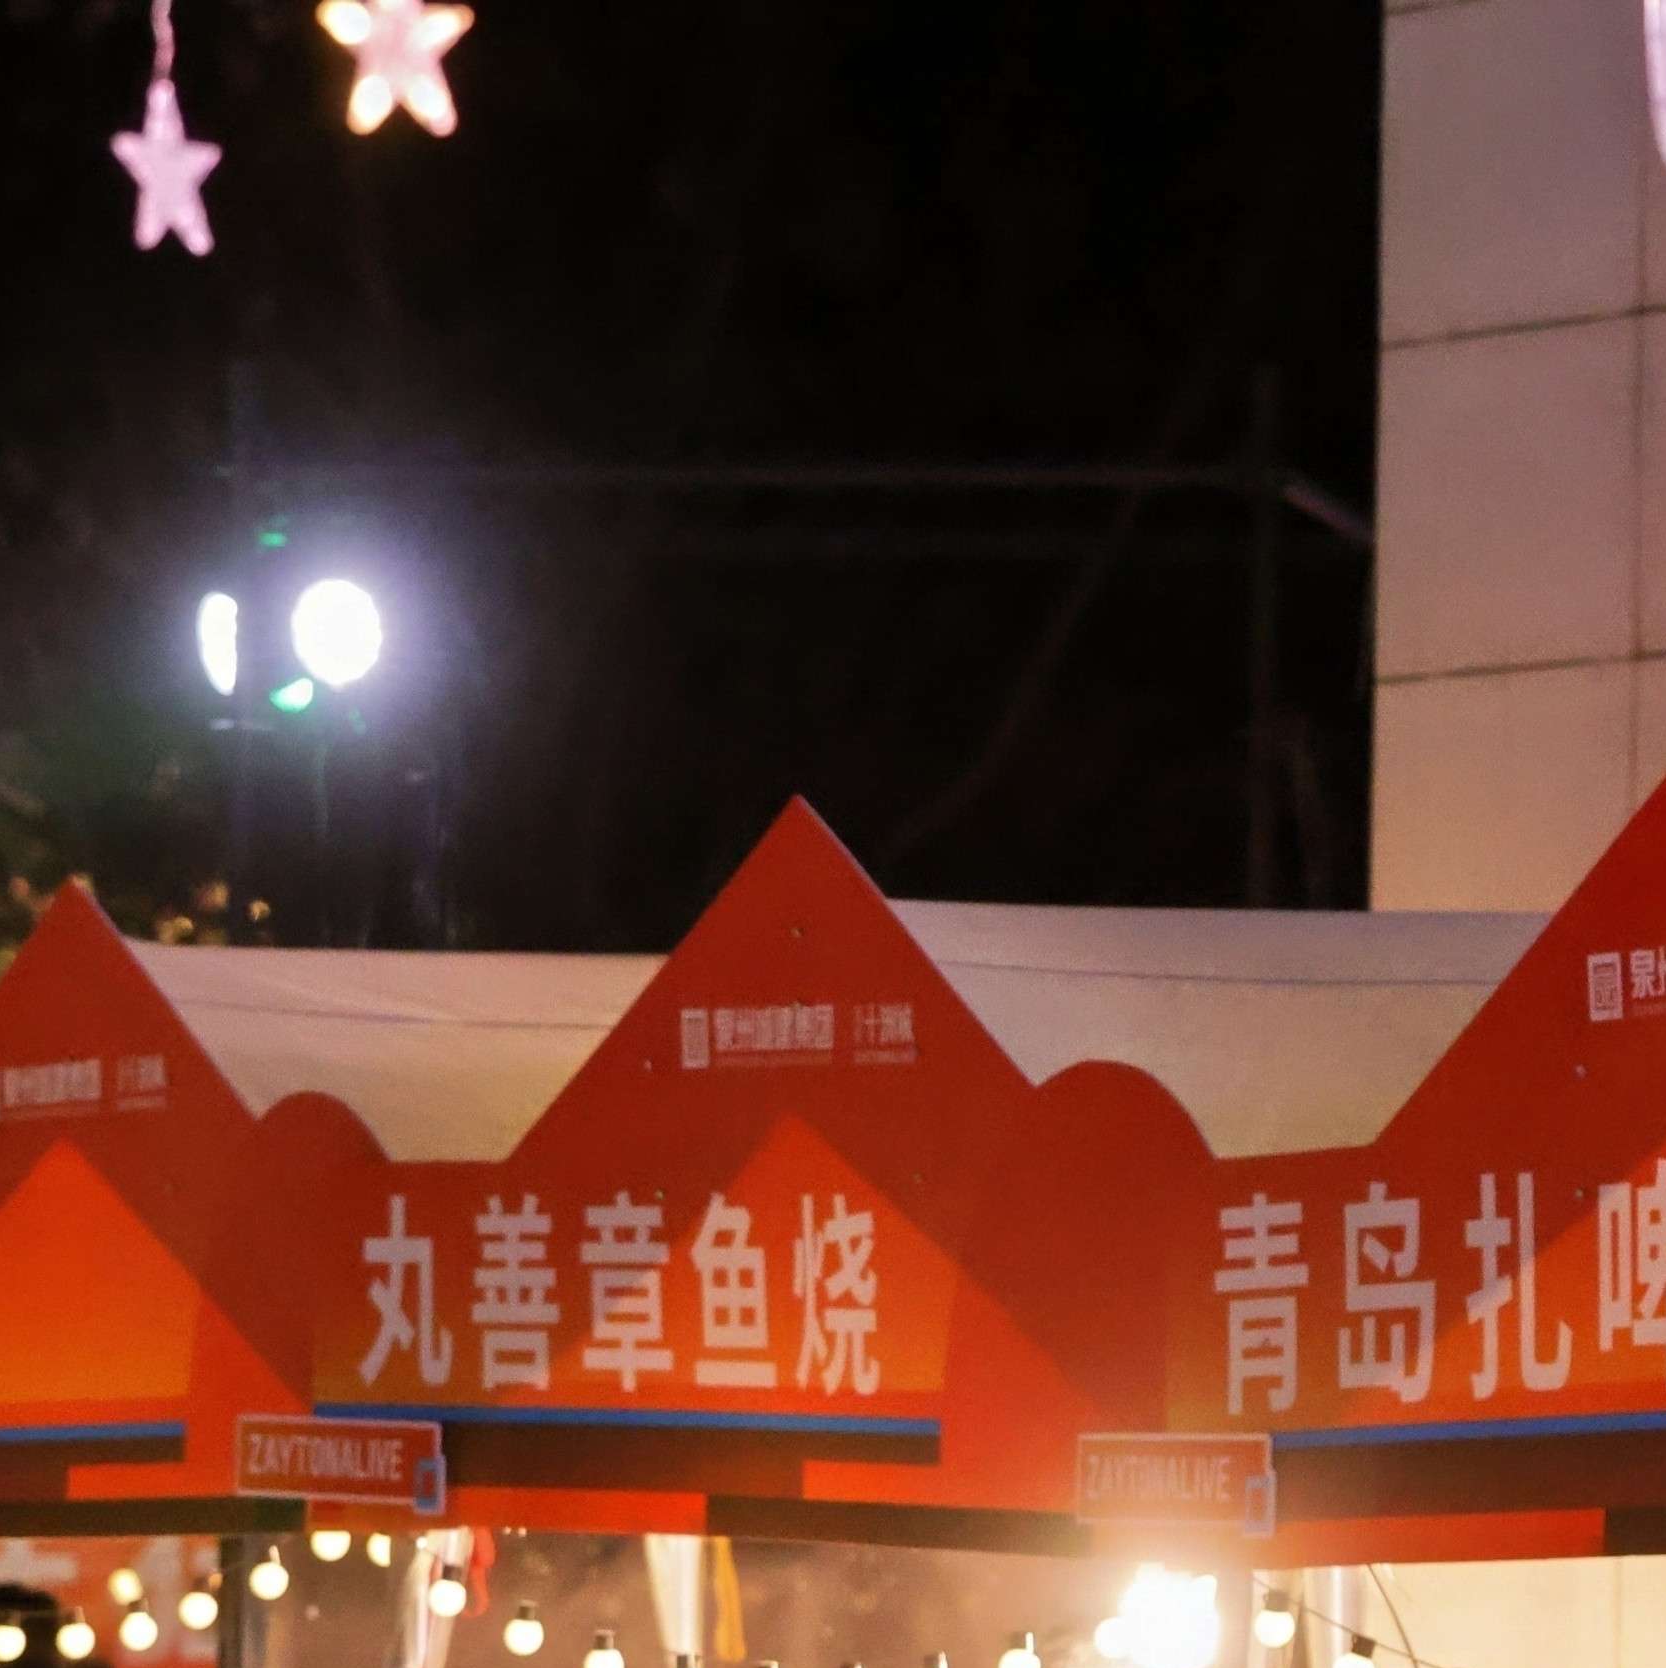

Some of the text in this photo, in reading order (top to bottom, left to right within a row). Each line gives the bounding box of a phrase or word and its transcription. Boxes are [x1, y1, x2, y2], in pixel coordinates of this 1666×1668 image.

[358, 1191, 882, 1398] 丸善章鱼烧
